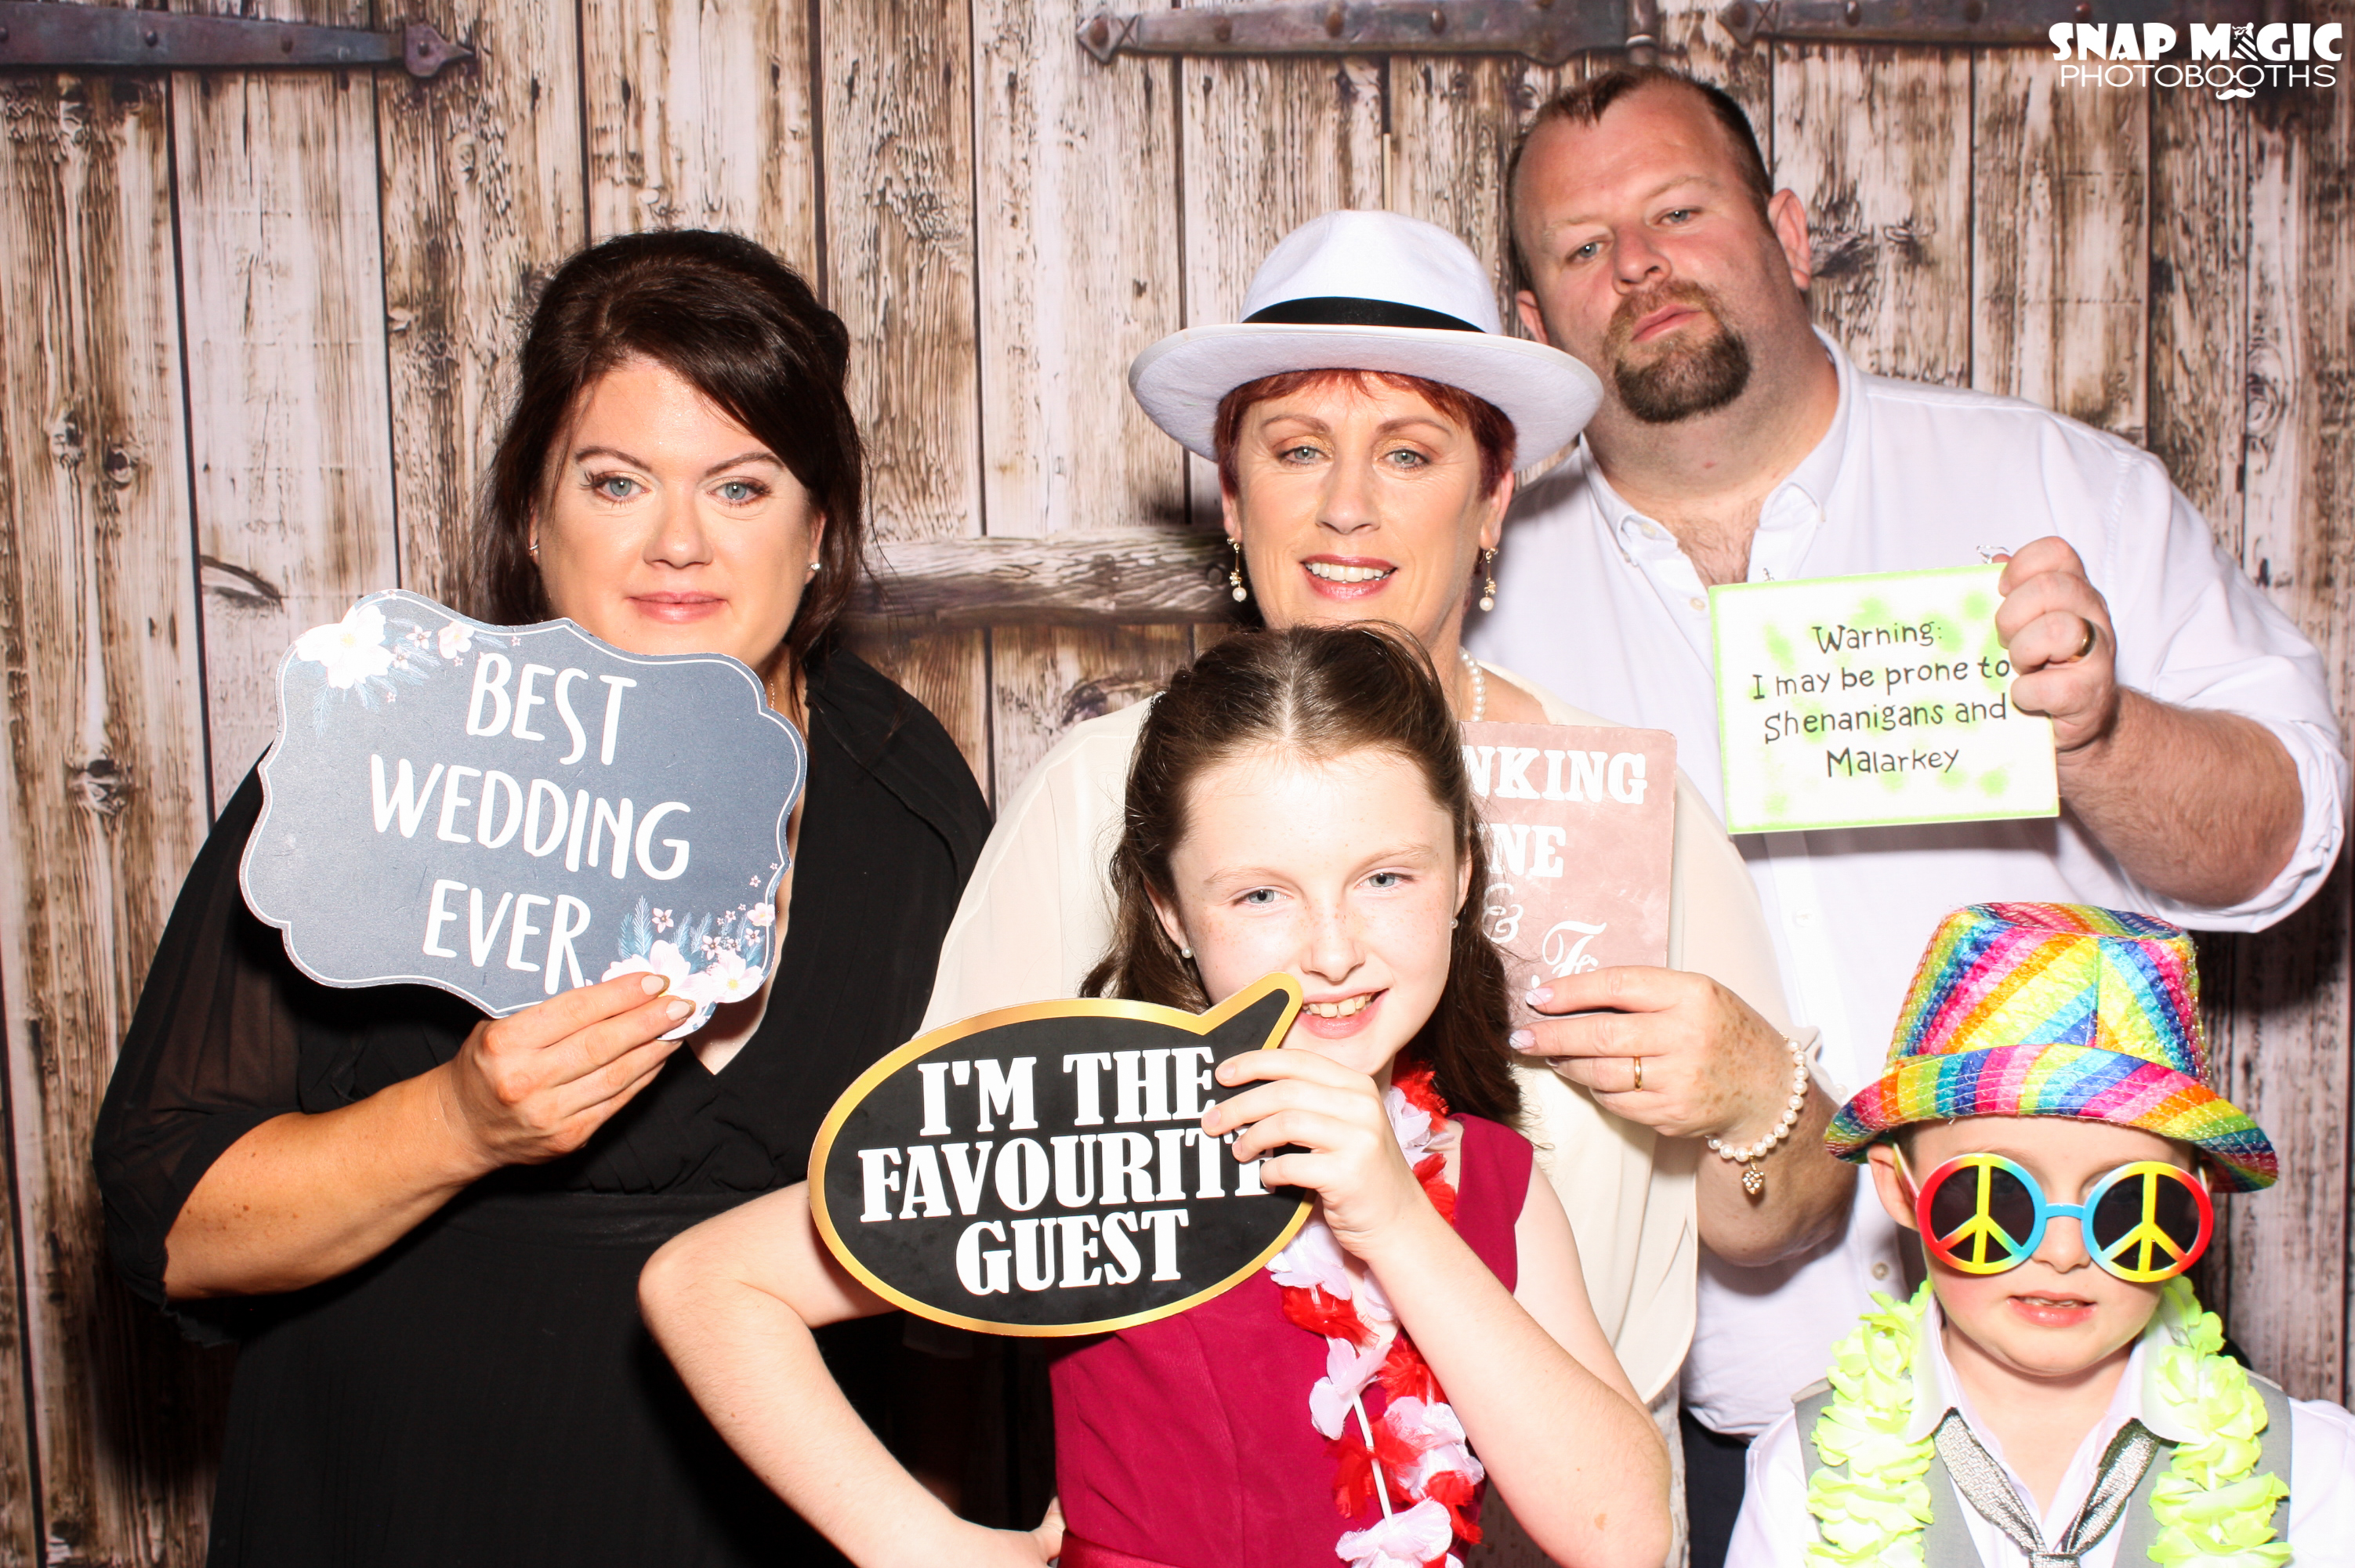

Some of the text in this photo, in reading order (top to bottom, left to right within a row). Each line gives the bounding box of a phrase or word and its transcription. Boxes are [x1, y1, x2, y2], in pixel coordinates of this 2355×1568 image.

[1812, 621, 1943, 654] Warning:
[1752, 657, 2010, 700] I may be prone to
[466, 653, 637, 766] BEST
[1765, 693, 2007, 744] Shenanigans and
[1462, 745, 1648, 805] NKING
[1827, 747, 1959, 777] Malarkey
[370, 754, 690, 880] WEDDING
[1478, 823, 1567, 878] NE
[422, 878, 591, 994] EVER
[918, 1047, 1216, 1136] I'M THE
[955, 1209, 1189, 1295] GUEST
